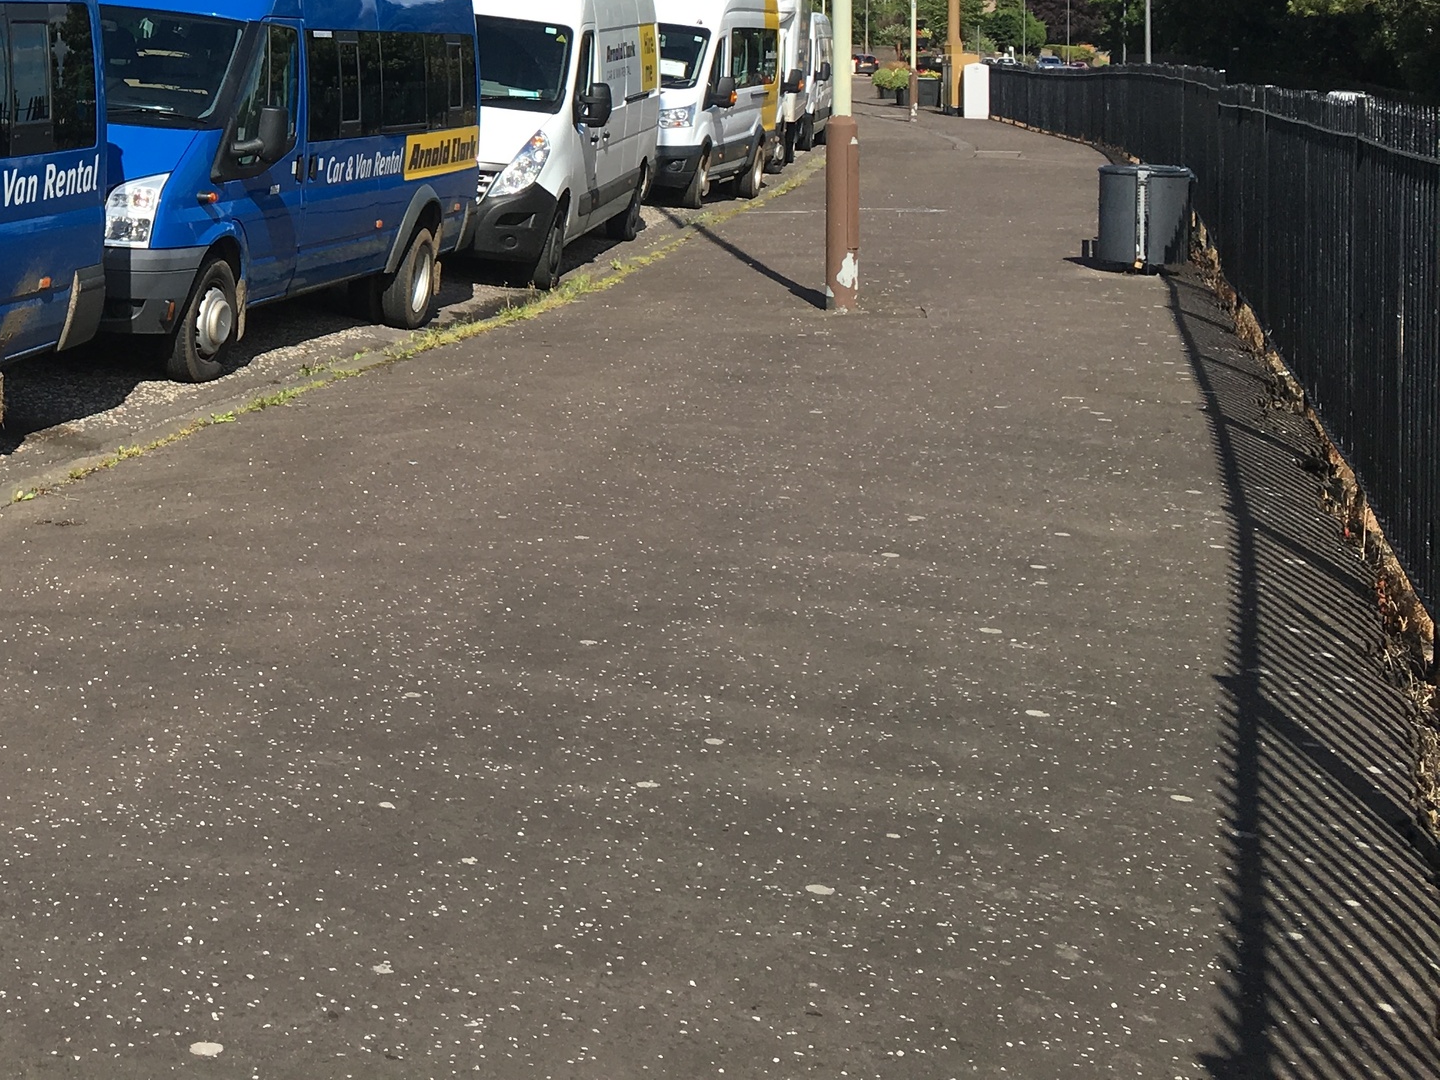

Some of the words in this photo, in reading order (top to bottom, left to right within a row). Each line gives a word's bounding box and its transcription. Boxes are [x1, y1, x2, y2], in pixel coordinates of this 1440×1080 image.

[326, 156, 345, 184] Car
[346, 157, 353, 181] &
[355, 151, 372, 179] Van
[373, 147, 404, 177] Rental
[408, 138, 451, 170] Arnold
[451, 135, 477, 163] Clark
[3, 168, 38, 207] Van
[43, 153, 100, 201] Rental
